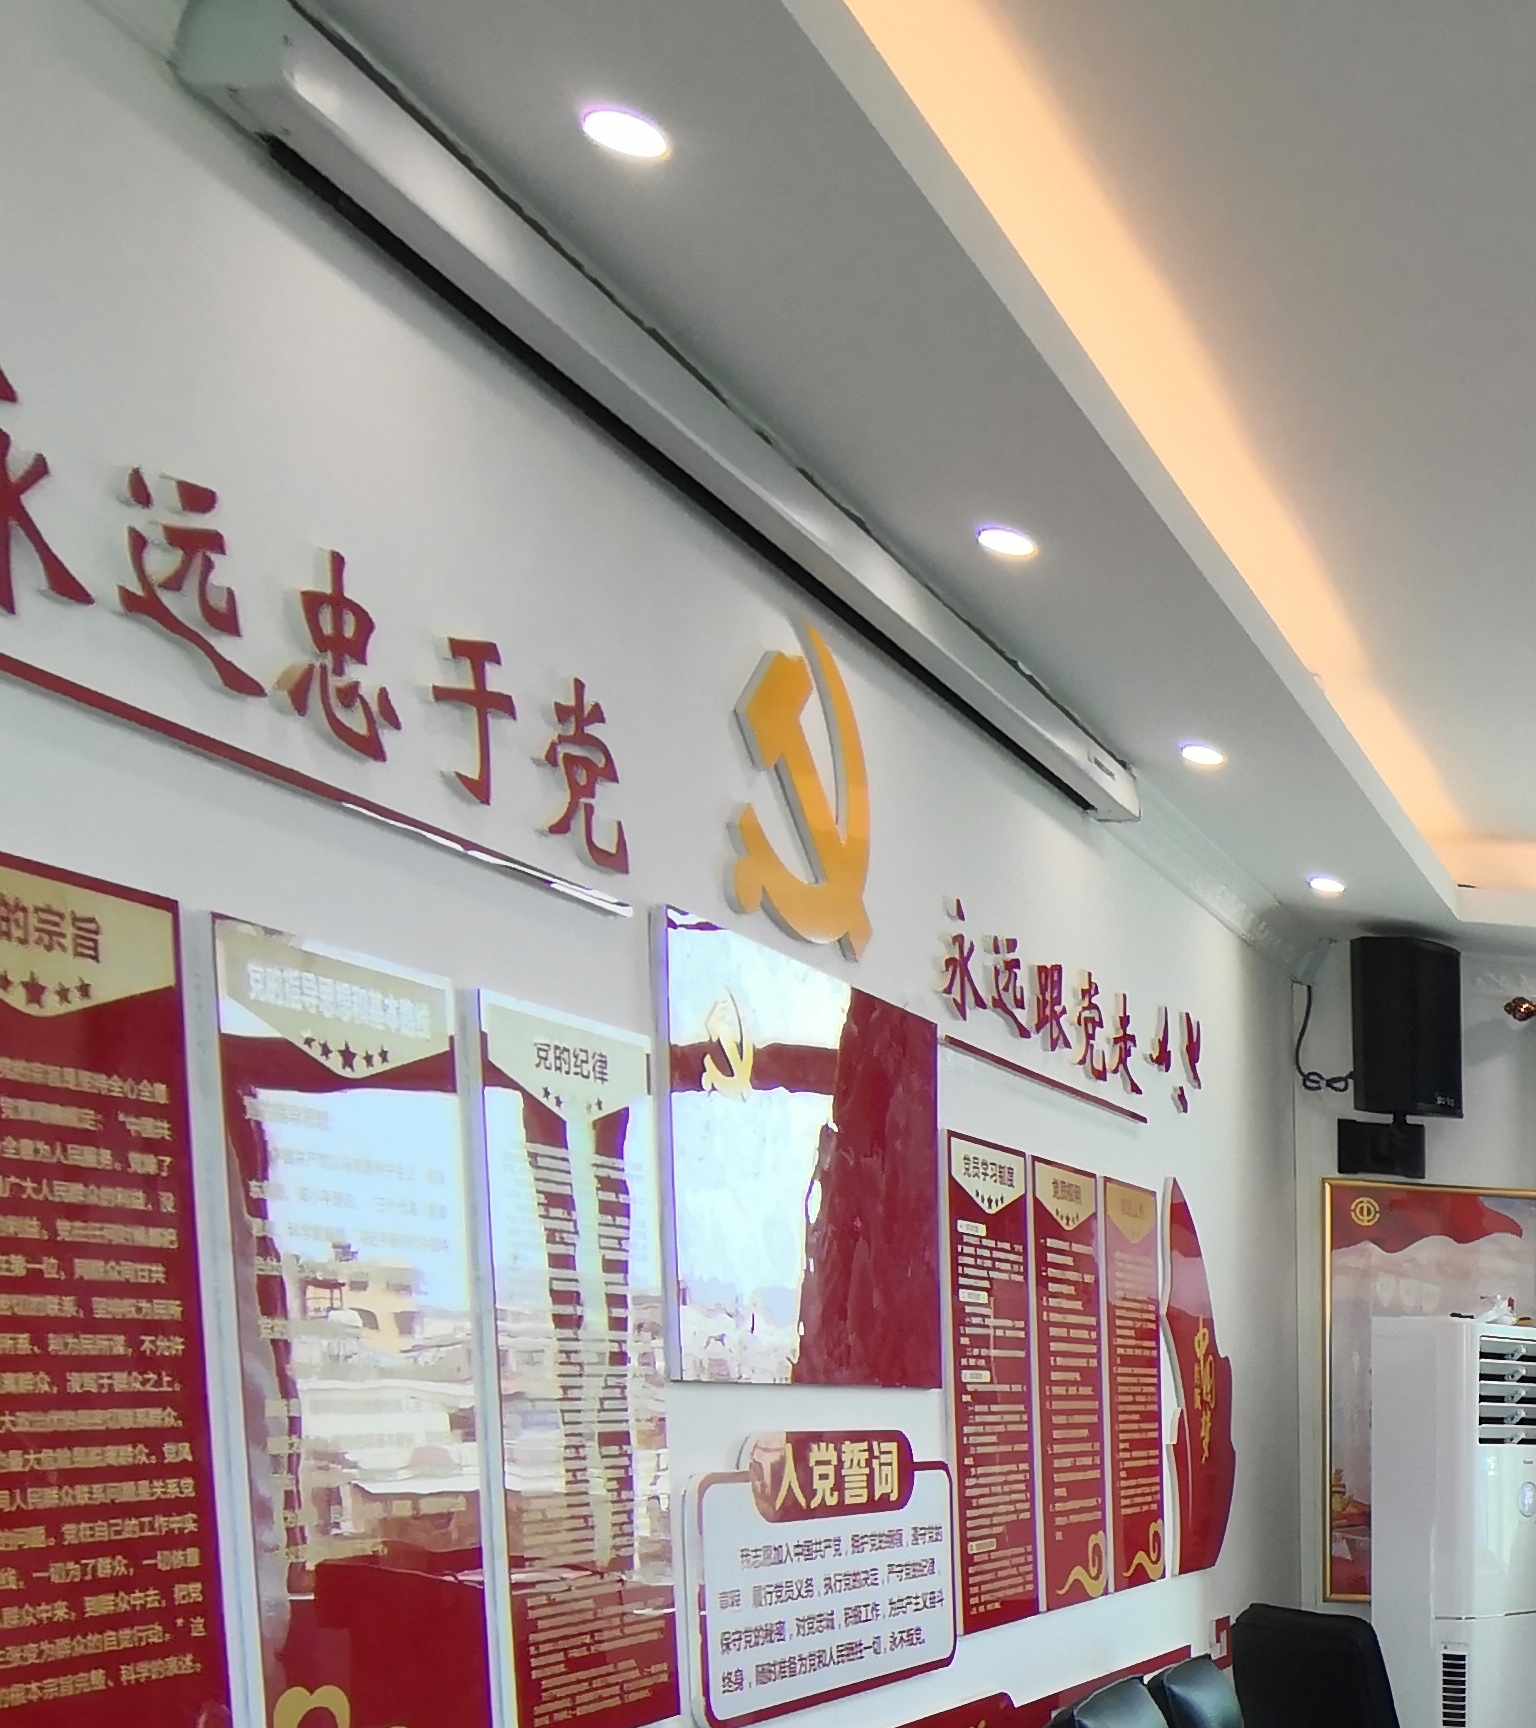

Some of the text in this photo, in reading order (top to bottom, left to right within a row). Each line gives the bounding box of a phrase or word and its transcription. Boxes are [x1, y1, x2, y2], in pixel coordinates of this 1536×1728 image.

[0, 893, 101, 963] 的宗旨
[942, 898, 1143, 1094] 永远跟党走
[534, 1042, 609, 1084] 党的纪律
[775, 1440, 900, 1512] 入党誓词
